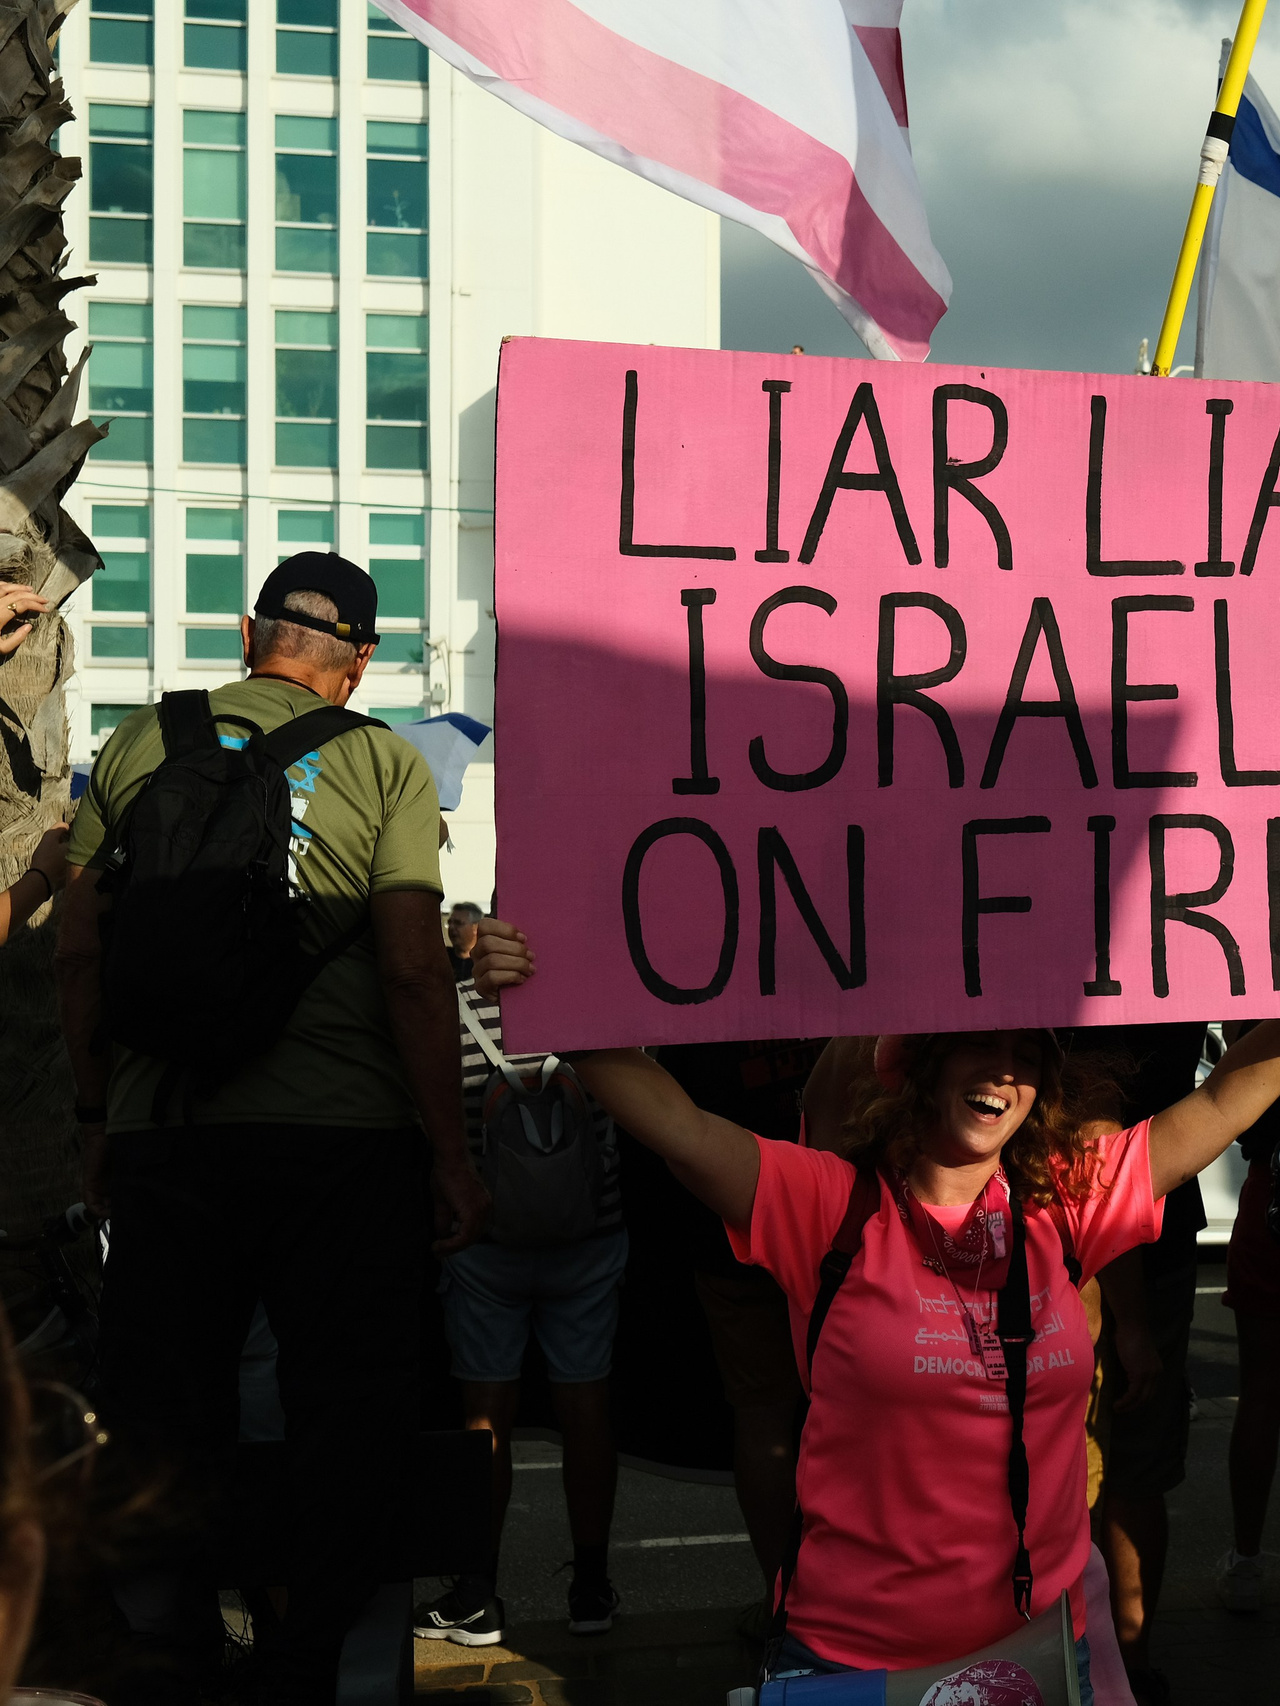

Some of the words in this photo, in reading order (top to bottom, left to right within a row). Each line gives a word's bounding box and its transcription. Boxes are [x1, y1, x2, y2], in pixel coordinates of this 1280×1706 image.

[619, 370, 1013, 571] LIAR
[621, 816, 867, 1005] ON
[1048, 1348, 1075, 1370] ALL
